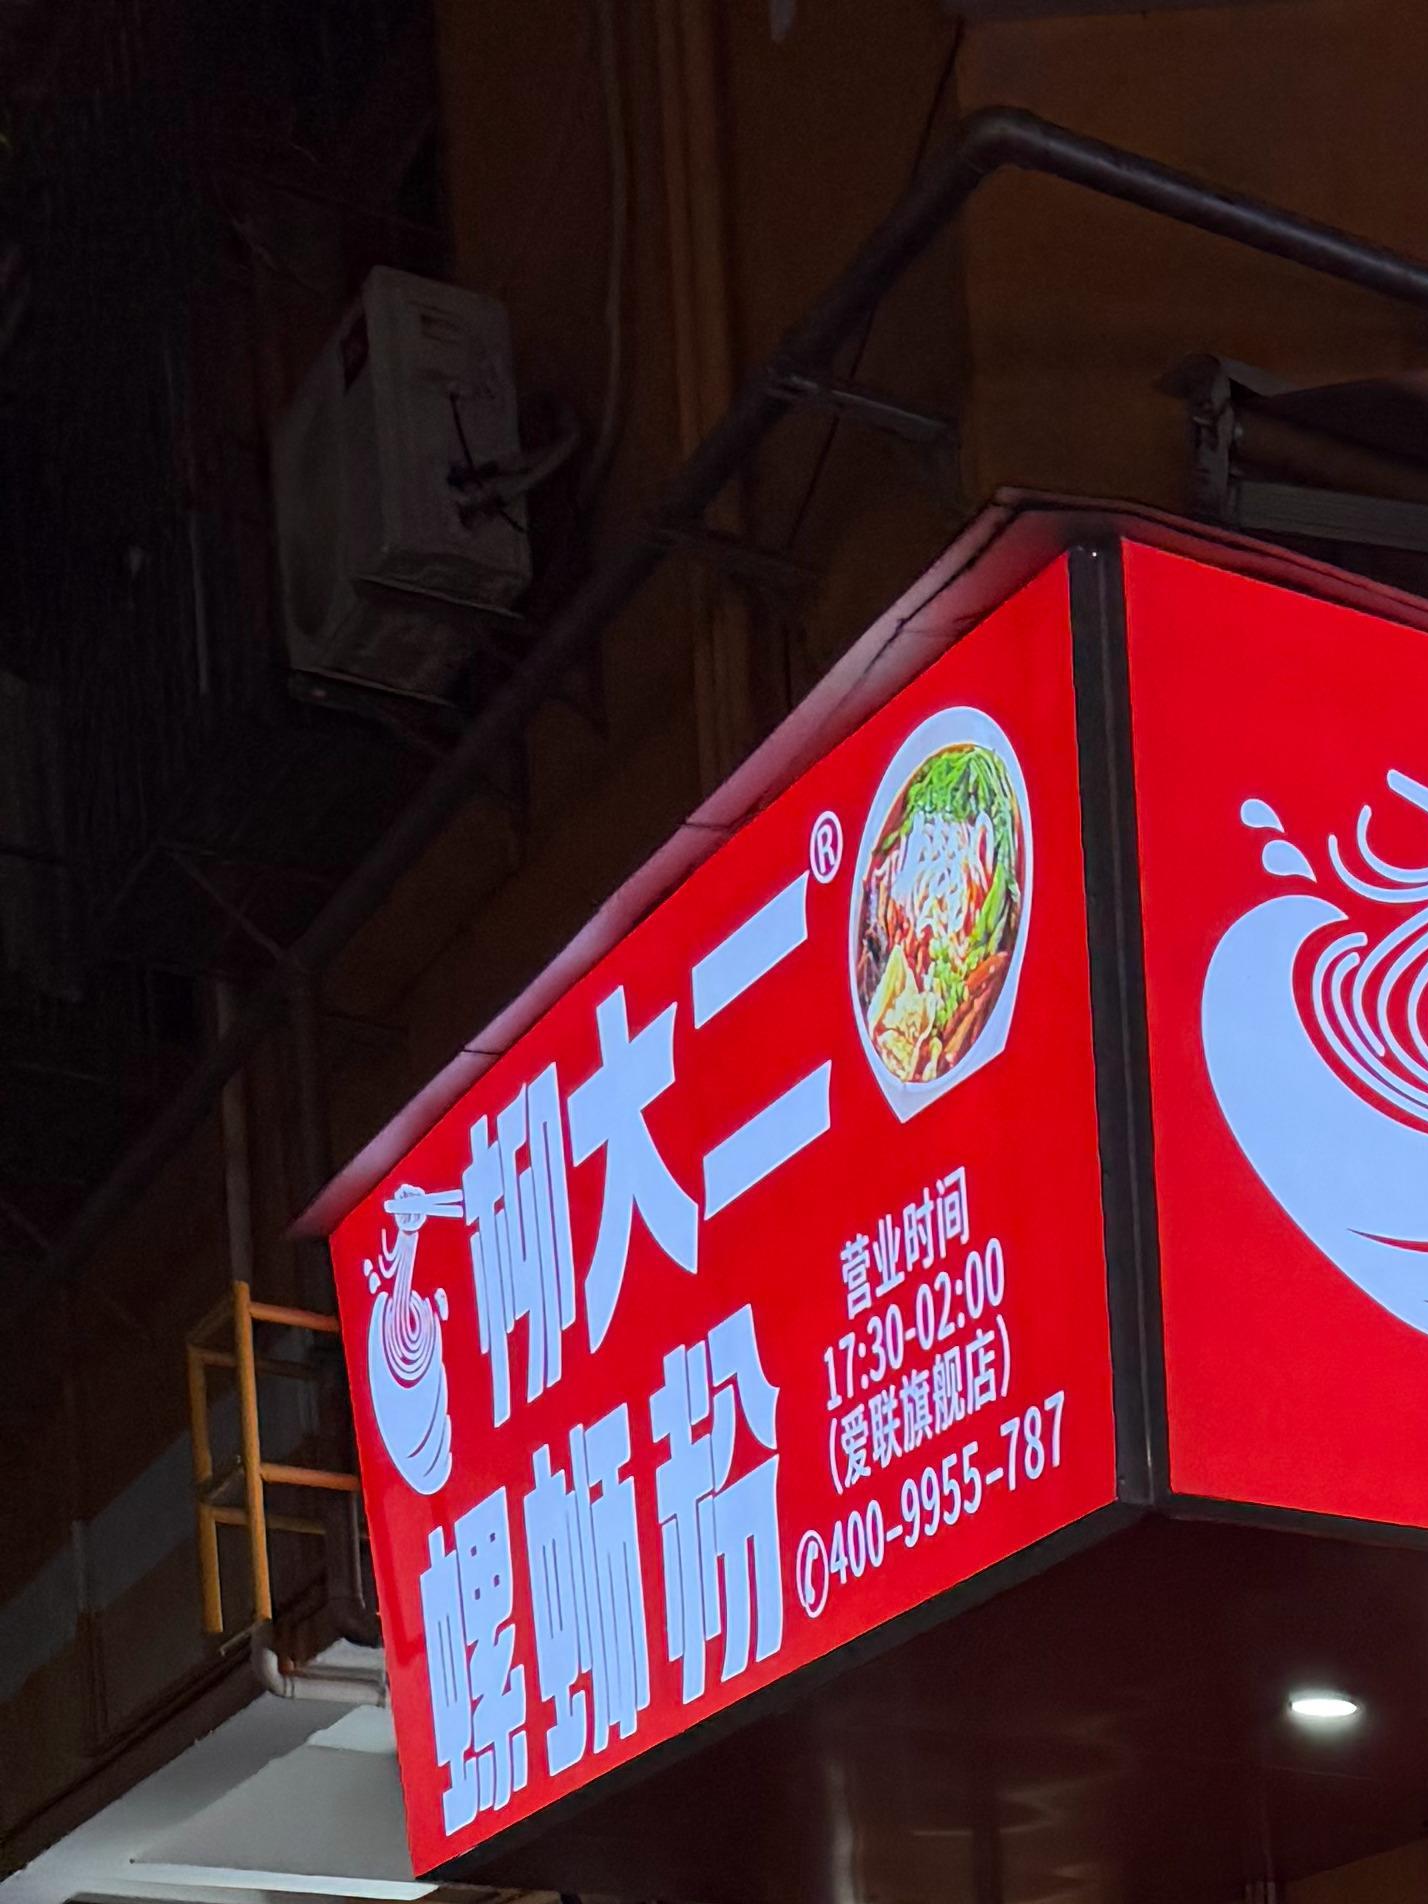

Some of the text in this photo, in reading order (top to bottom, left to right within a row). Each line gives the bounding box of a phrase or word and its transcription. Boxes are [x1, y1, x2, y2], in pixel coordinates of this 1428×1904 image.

[462, 872, 832, 1427] 柳大二
[840, 1167, 970, 1320] 营业时间
[823, 1237, 1006, 1411] 17:30-02:00
[419, 1303, 782, 1835] 螺蛳粉
[827, 1391, 1066, 1587] 400-9955-787
